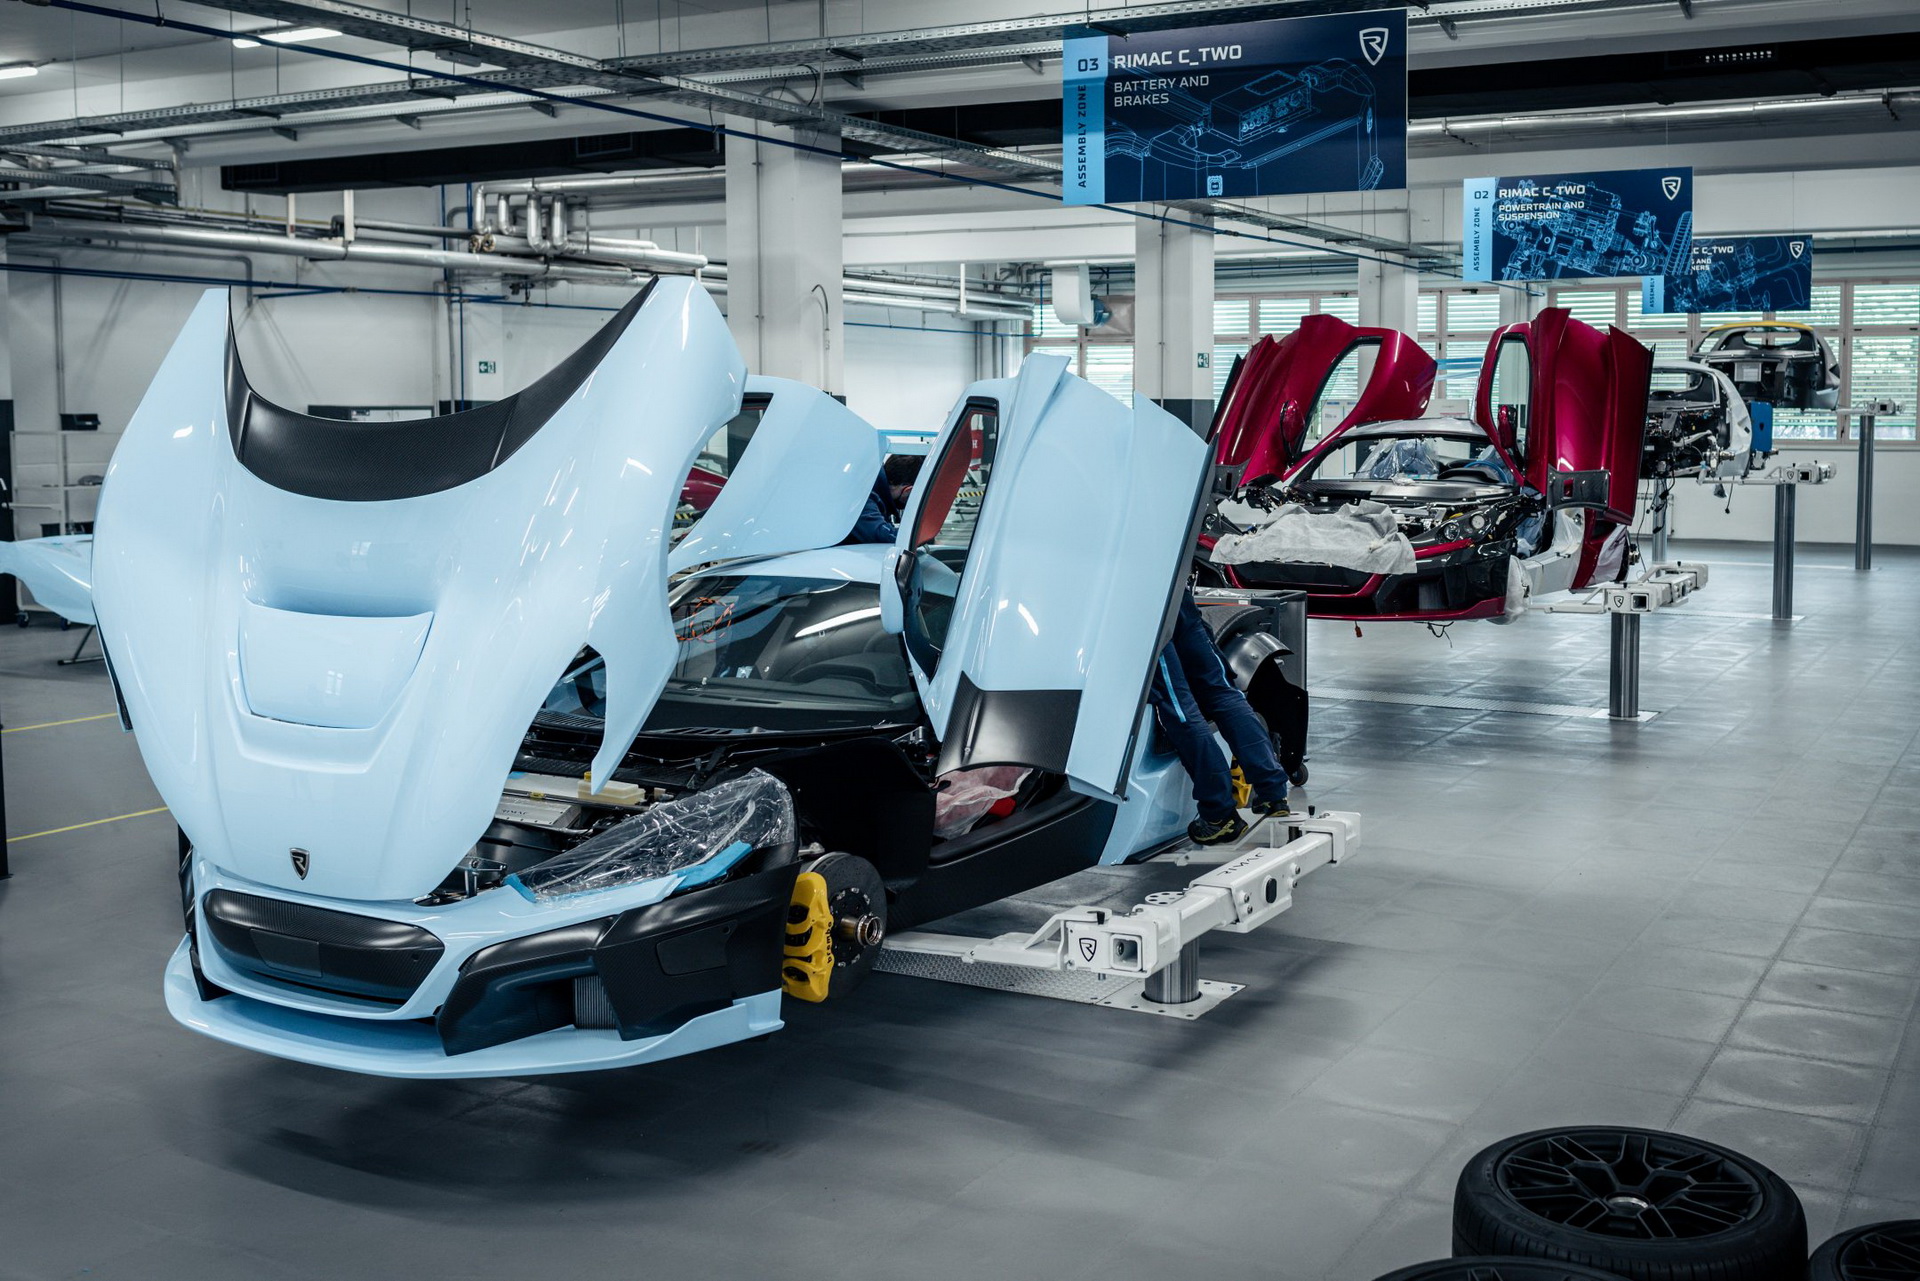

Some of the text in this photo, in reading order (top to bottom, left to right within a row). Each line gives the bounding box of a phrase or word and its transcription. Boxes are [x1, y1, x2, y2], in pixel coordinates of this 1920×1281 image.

[1114, 44, 1242, 68] RIMAC C_TWO
[1078, 58, 1098, 72] 03
[1114, 75, 1209, 93] BATTERY AND
[1114, 93, 1170, 107] BRAKES
[1078, 84, 1086, 188] ASSEMBLY ZONE
[1474, 190, 1488, 200] 02
[1499, 185, 1586, 198] RIMAC C_TWO
[1498, 201, 1585, 212] POWERTRAIN AND
[1498, 212, 1560, 221] SUSPENSION
[1702, 246, 1734, 255] C_TWO
